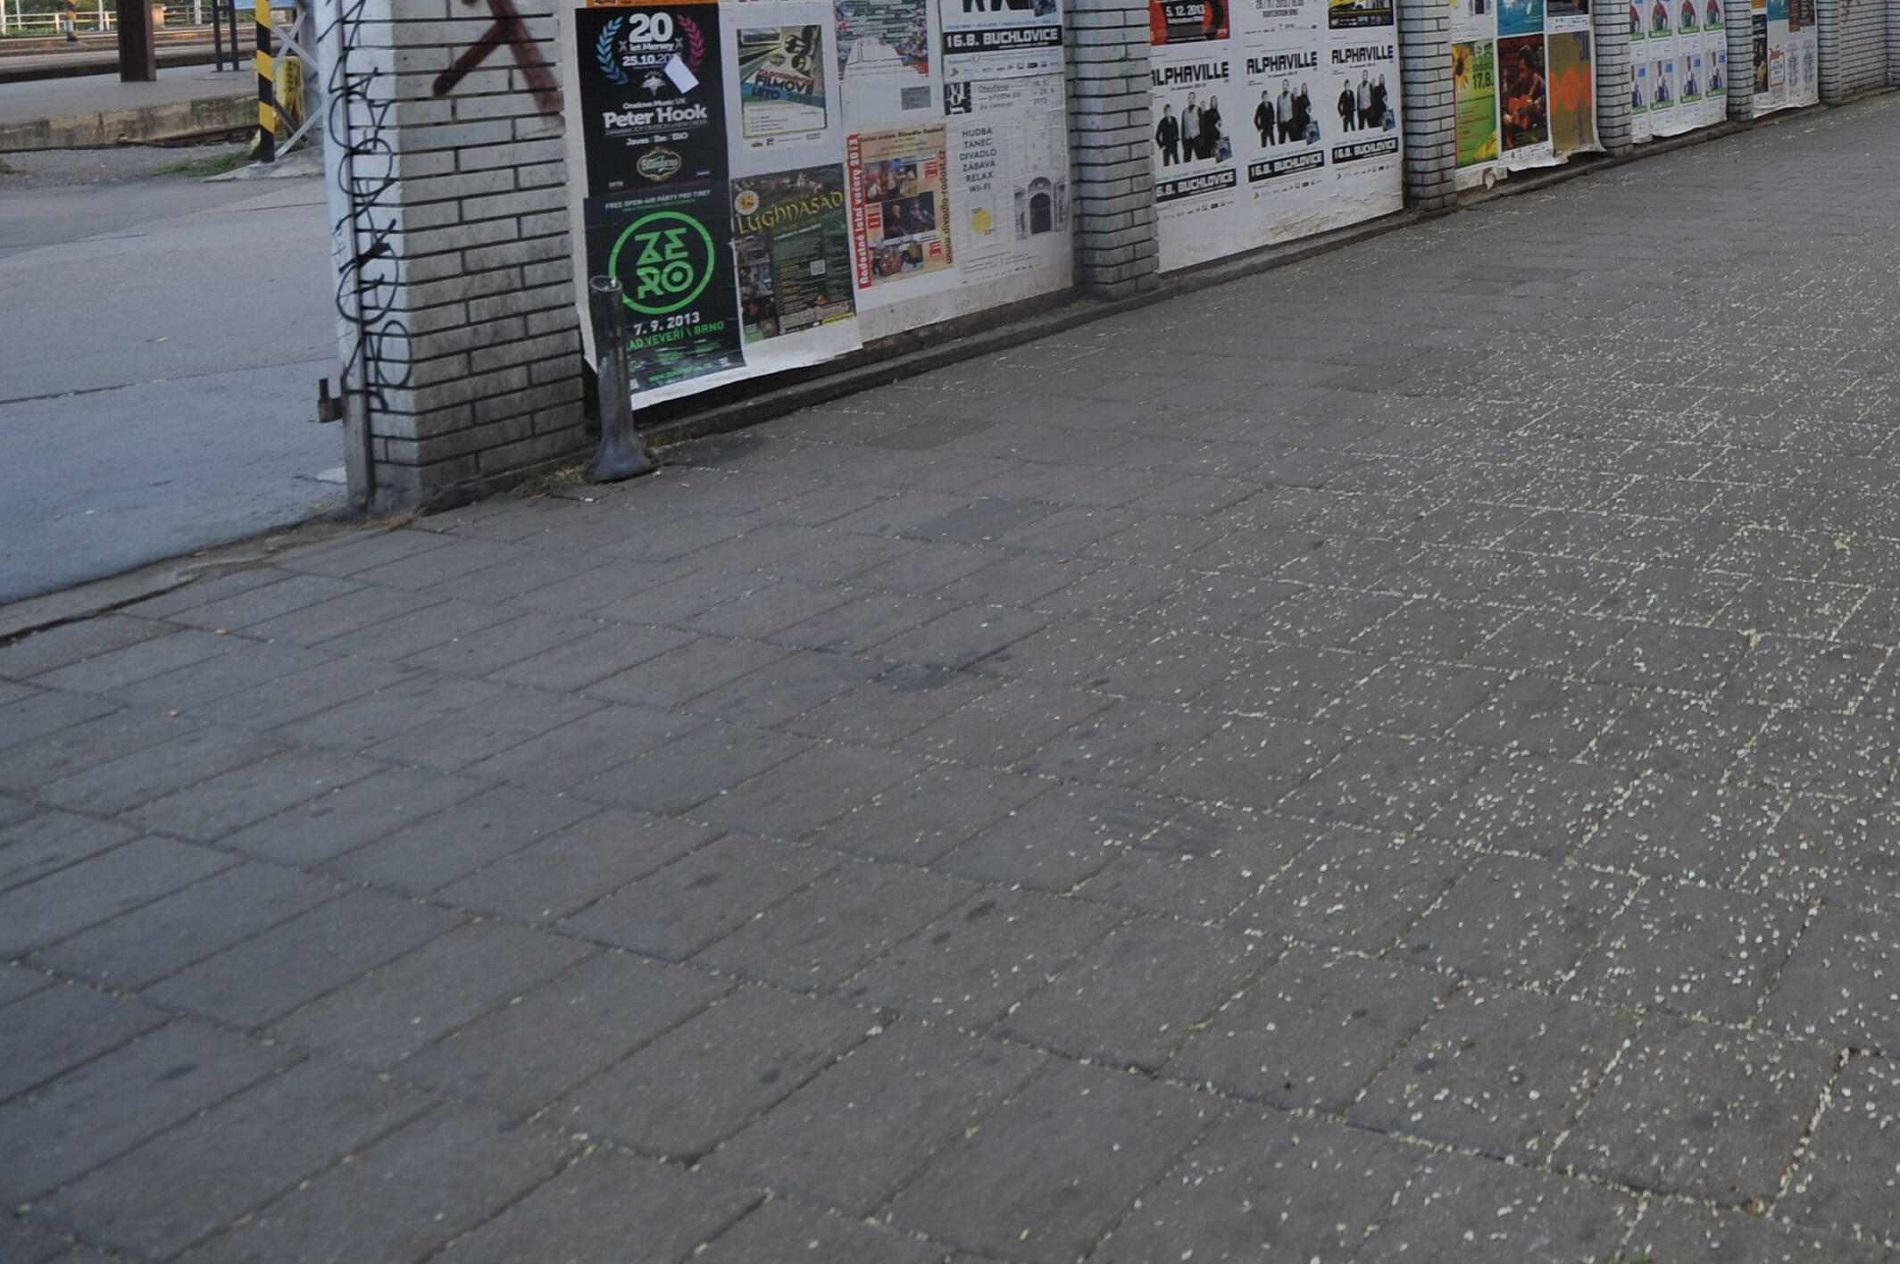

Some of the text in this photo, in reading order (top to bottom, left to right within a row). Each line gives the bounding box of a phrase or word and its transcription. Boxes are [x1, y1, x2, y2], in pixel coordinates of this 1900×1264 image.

[1187, 3, 1205, 15] 2013
[628, 12, 674, 43] 20
[946, 27, 1058, 49] 16.8. BUCHLOVICE
[622, 53, 678, 67] 25.10.20
[1246, 51, 1318, 75] ALPHAVILLE
[1332, 45, 1394, 64] ALPHAVILLE
[1472, 72, 1494, 89] 17.8.
[603, 110, 653, 129] Peter
[656, 104, 708, 123] Hook
[962, 127, 992, 137] HUDBA
[964, 137, 992, 148] TANEC
[1354, 139, 1396, 156] BUCHLOVICE
[960, 148, 998, 161] DIVADLO
[1274, 153, 1322, 172] BUCHLOVICE
[965, 171, 993, 183] RELAX
[1178, 171, 1234, 193] BUCHLOVICE
[736, 191, 844, 235] LUGHNASAD
[633, 311, 700, 336] 7. 9. 2013
[694, 321, 724, 336] BRNO
